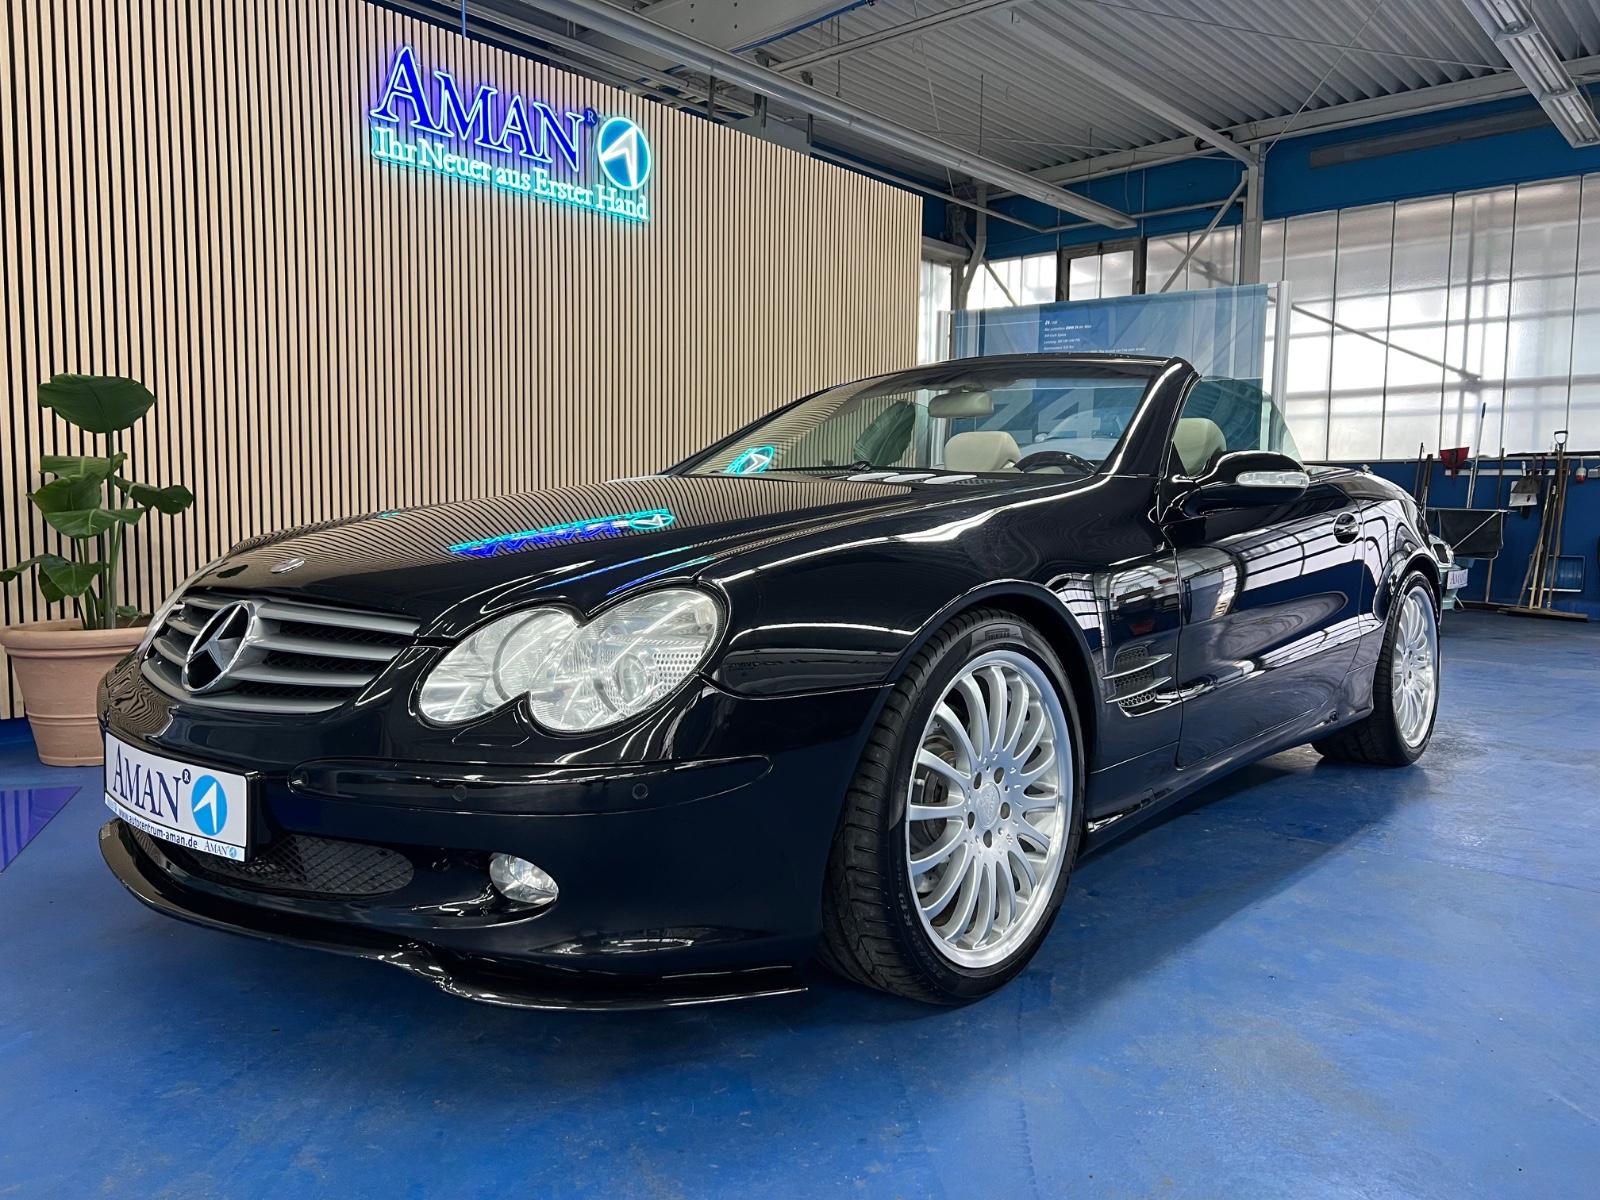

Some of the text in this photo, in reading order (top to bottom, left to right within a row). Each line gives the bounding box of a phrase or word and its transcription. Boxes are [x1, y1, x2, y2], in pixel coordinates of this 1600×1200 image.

[374, 126, 649, 220] Ihr Neuer aus Erster Hand
